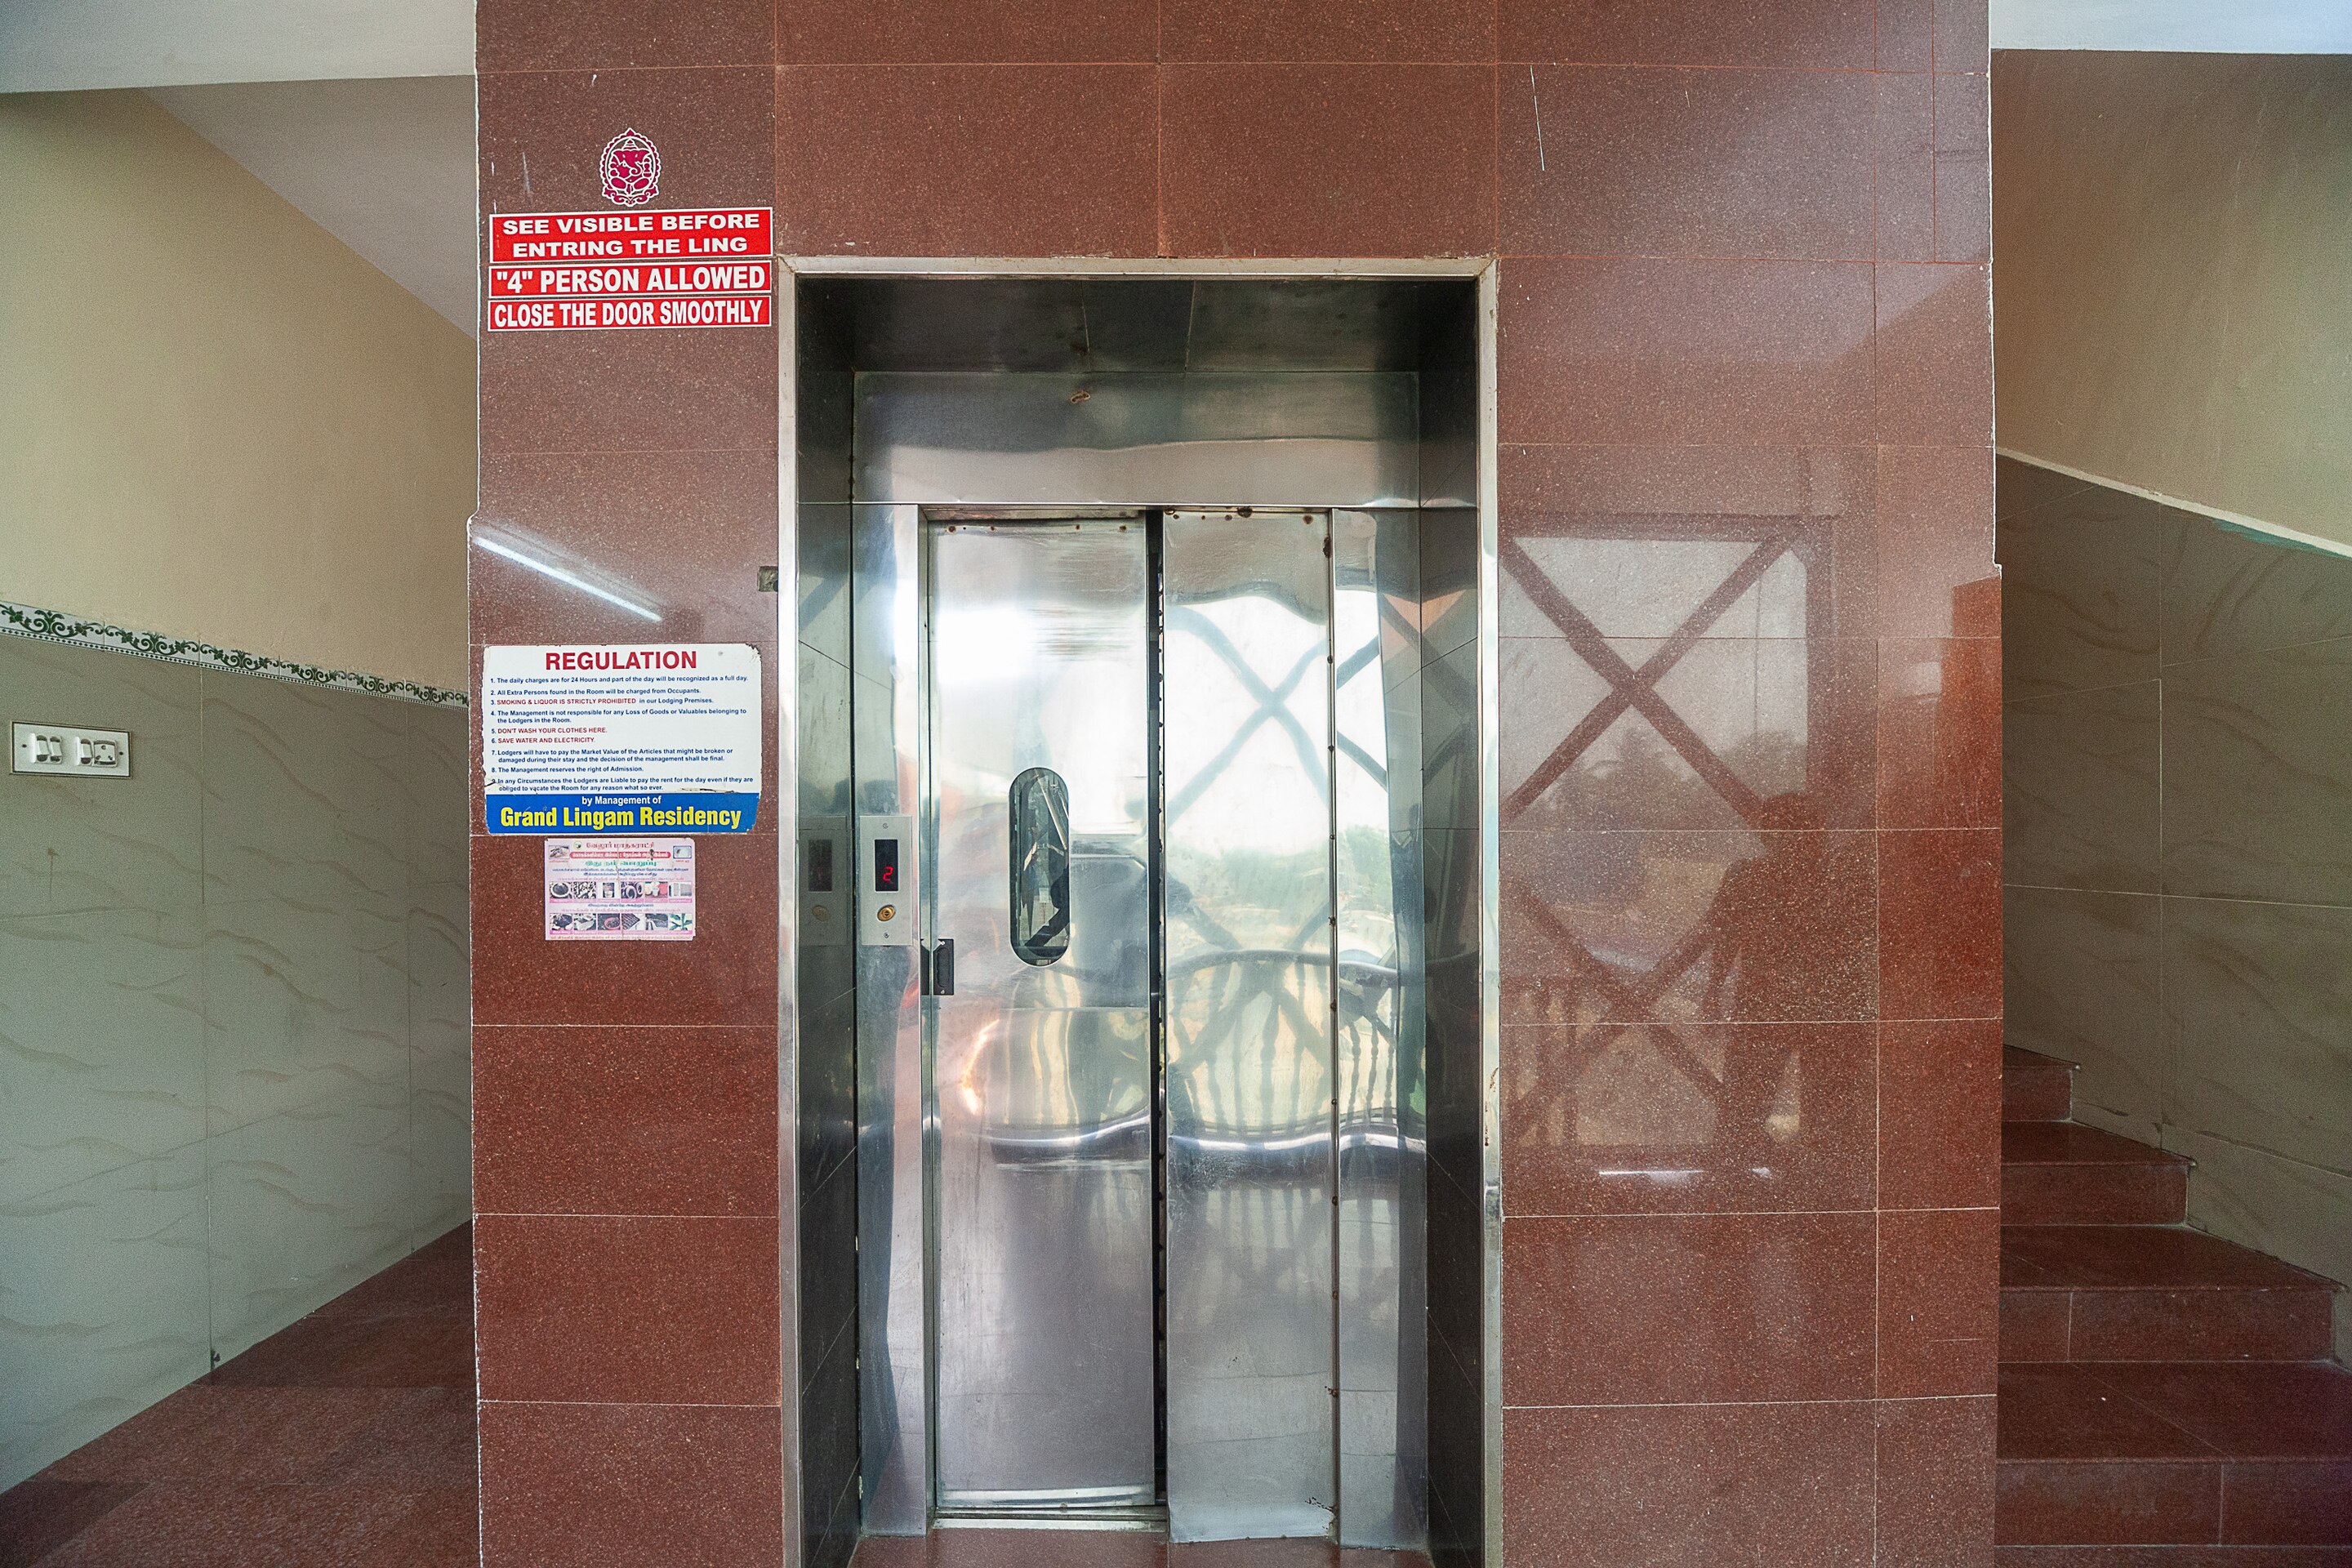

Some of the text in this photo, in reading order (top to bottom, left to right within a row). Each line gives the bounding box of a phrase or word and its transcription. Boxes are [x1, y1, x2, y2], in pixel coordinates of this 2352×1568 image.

[503, 214, 760, 234] SEE VISIBLE BEFORE
[513, 237, 747, 258] ENTRING THE LING
[497, 266, 764, 293] "4" PERSON ALLOWED
[495, 300, 762, 327] CLOSE THE DOOR SMOOTHLY
[546, 651, 696, 670] REGULATION
[581, 795, 662, 806] by Management of
[501, 806, 742, 830] Grand Lingam Residency
[883, 866, 893, 881] 2
